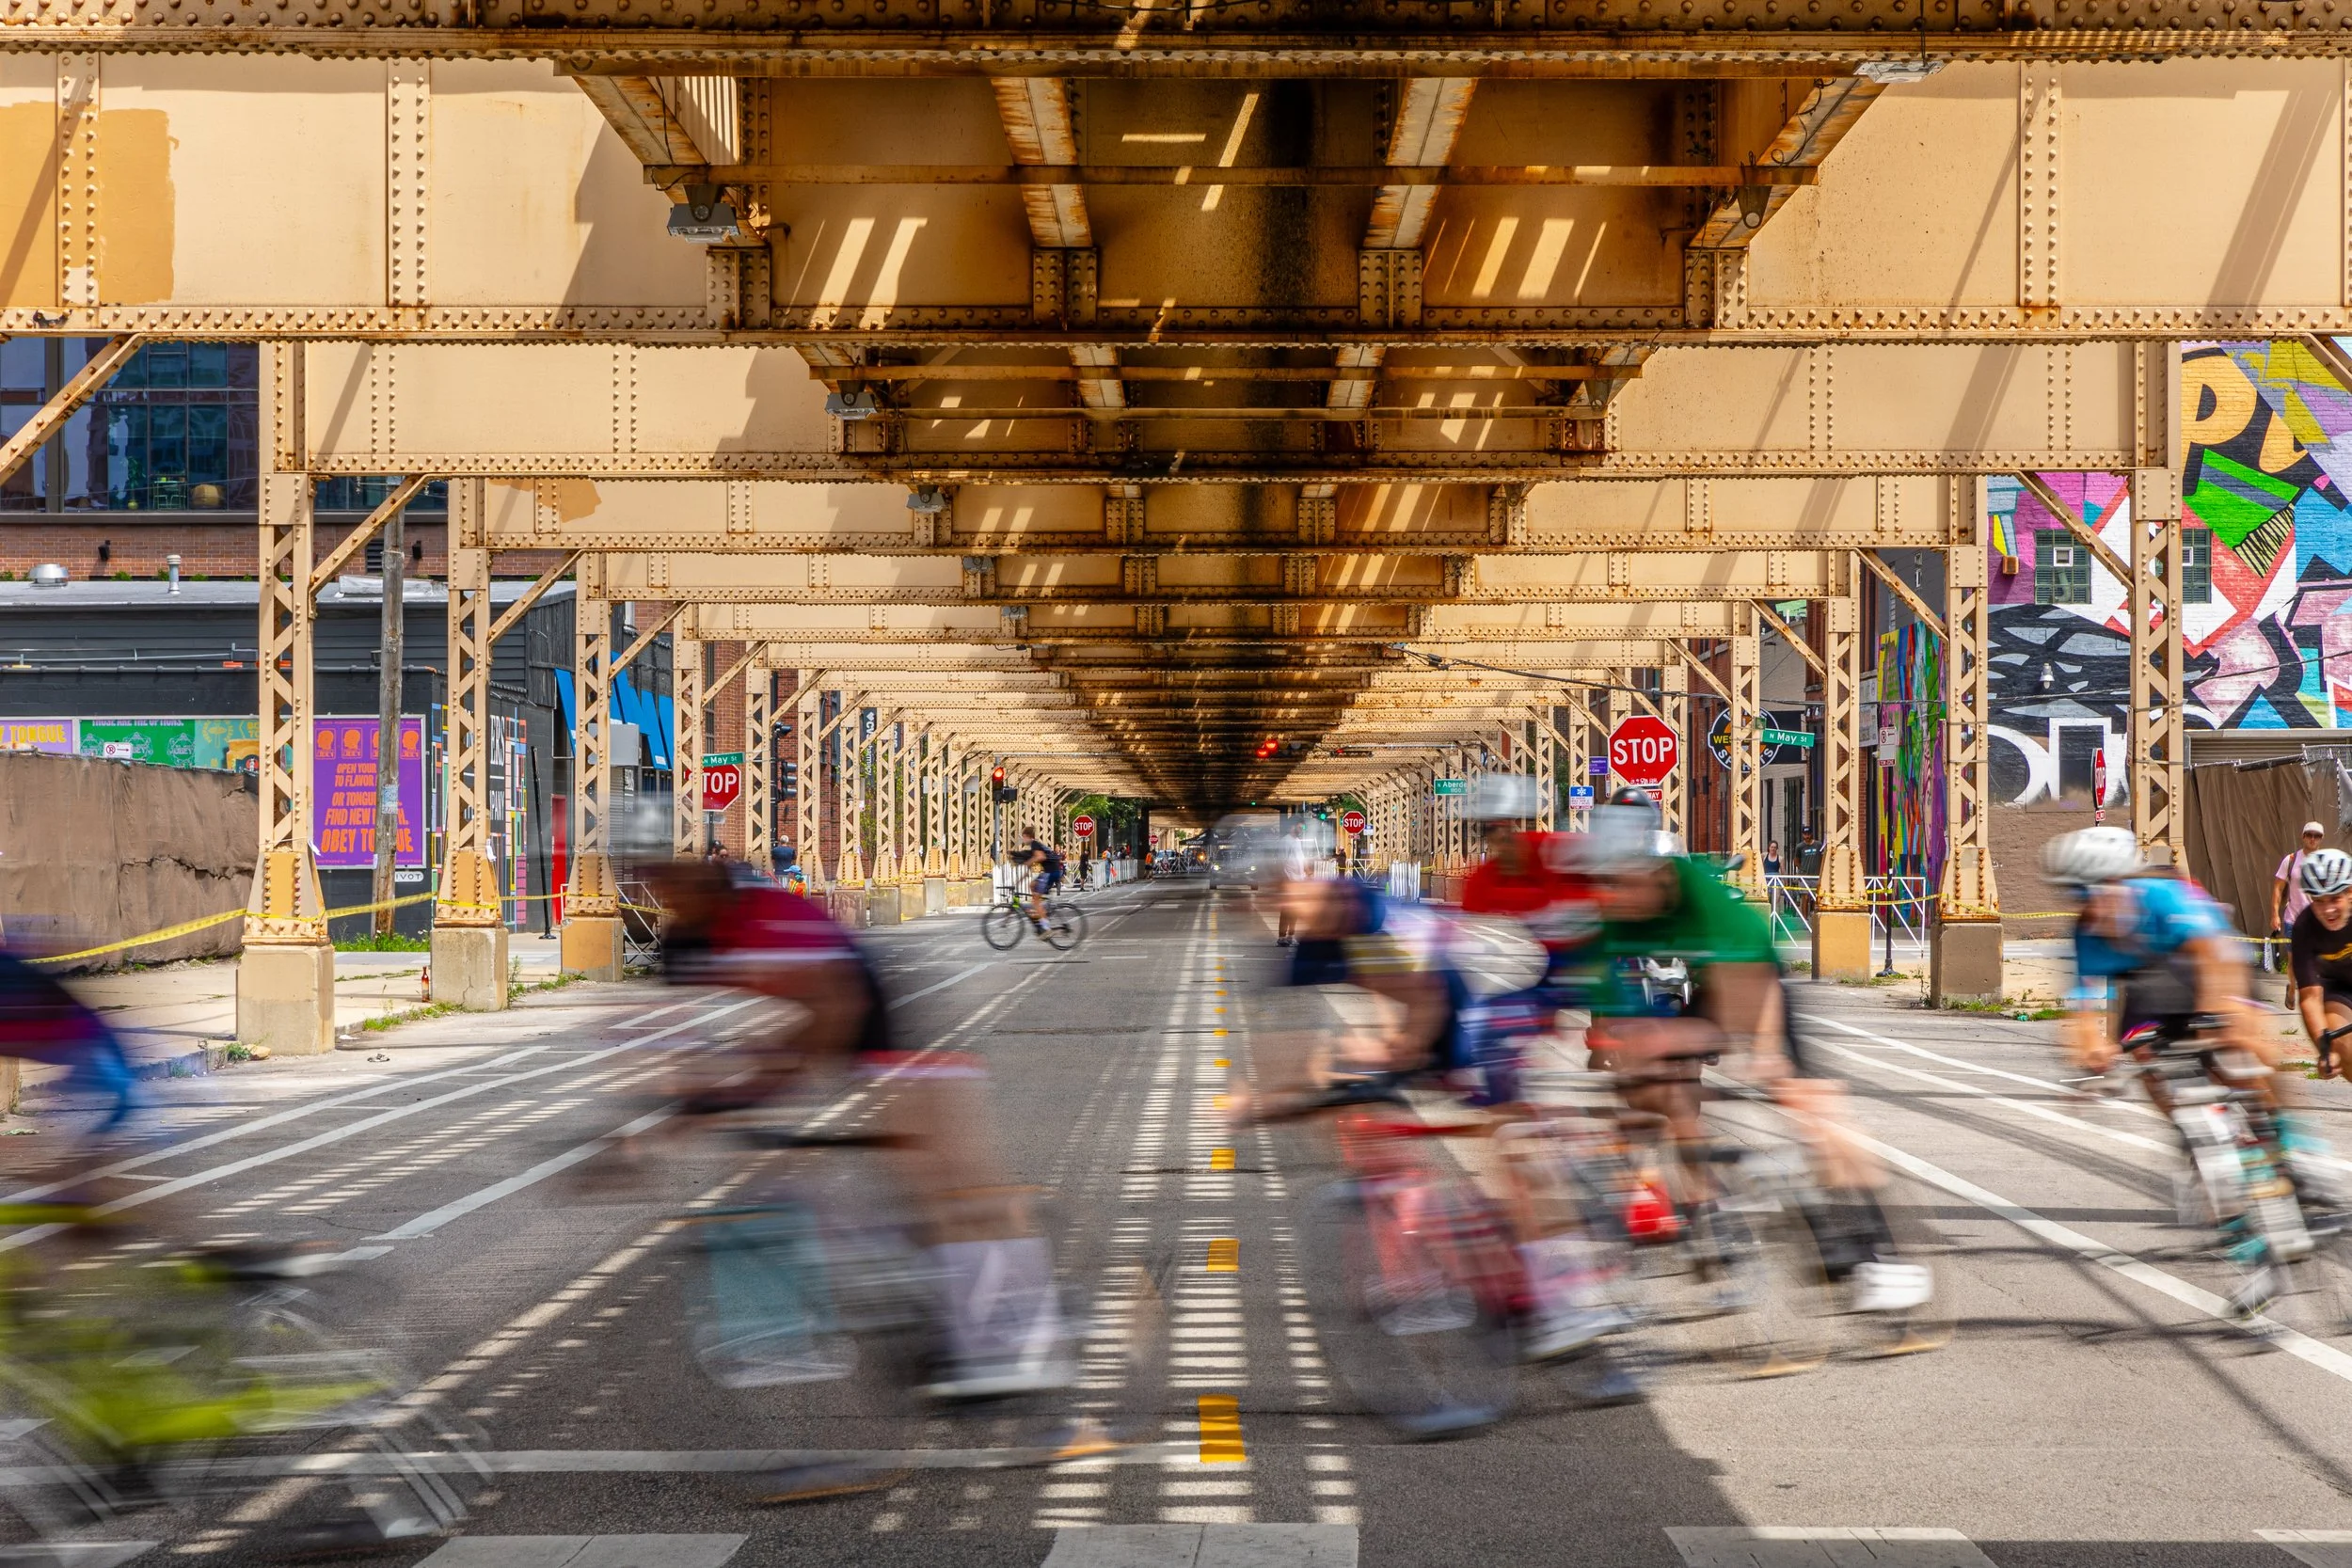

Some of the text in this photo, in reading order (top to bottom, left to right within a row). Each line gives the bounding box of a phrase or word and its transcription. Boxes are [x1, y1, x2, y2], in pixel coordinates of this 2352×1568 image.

[10, 724, 67, 743] TONGUE
[1777, 732, 1797, 744] May
[1613, 736, 1674, 765] STOP
[710, 756, 728, 766] May
[337, 763, 377, 774] OPEN YOUR
[335, 775, 374, 787] TO FLAVOR
[689, 771, 738, 794] TOP
[332, 791, 345, 807] OR
[346, 791, 376, 807] TONGU
[325, 808, 348, 826] FIND
[349, 808, 371, 826] NEW
[1343, 818, 1364, 828] STOP
[1074, 822, 1093, 831] STOP
[321, 828, 414, 853] OBEY TOUE
